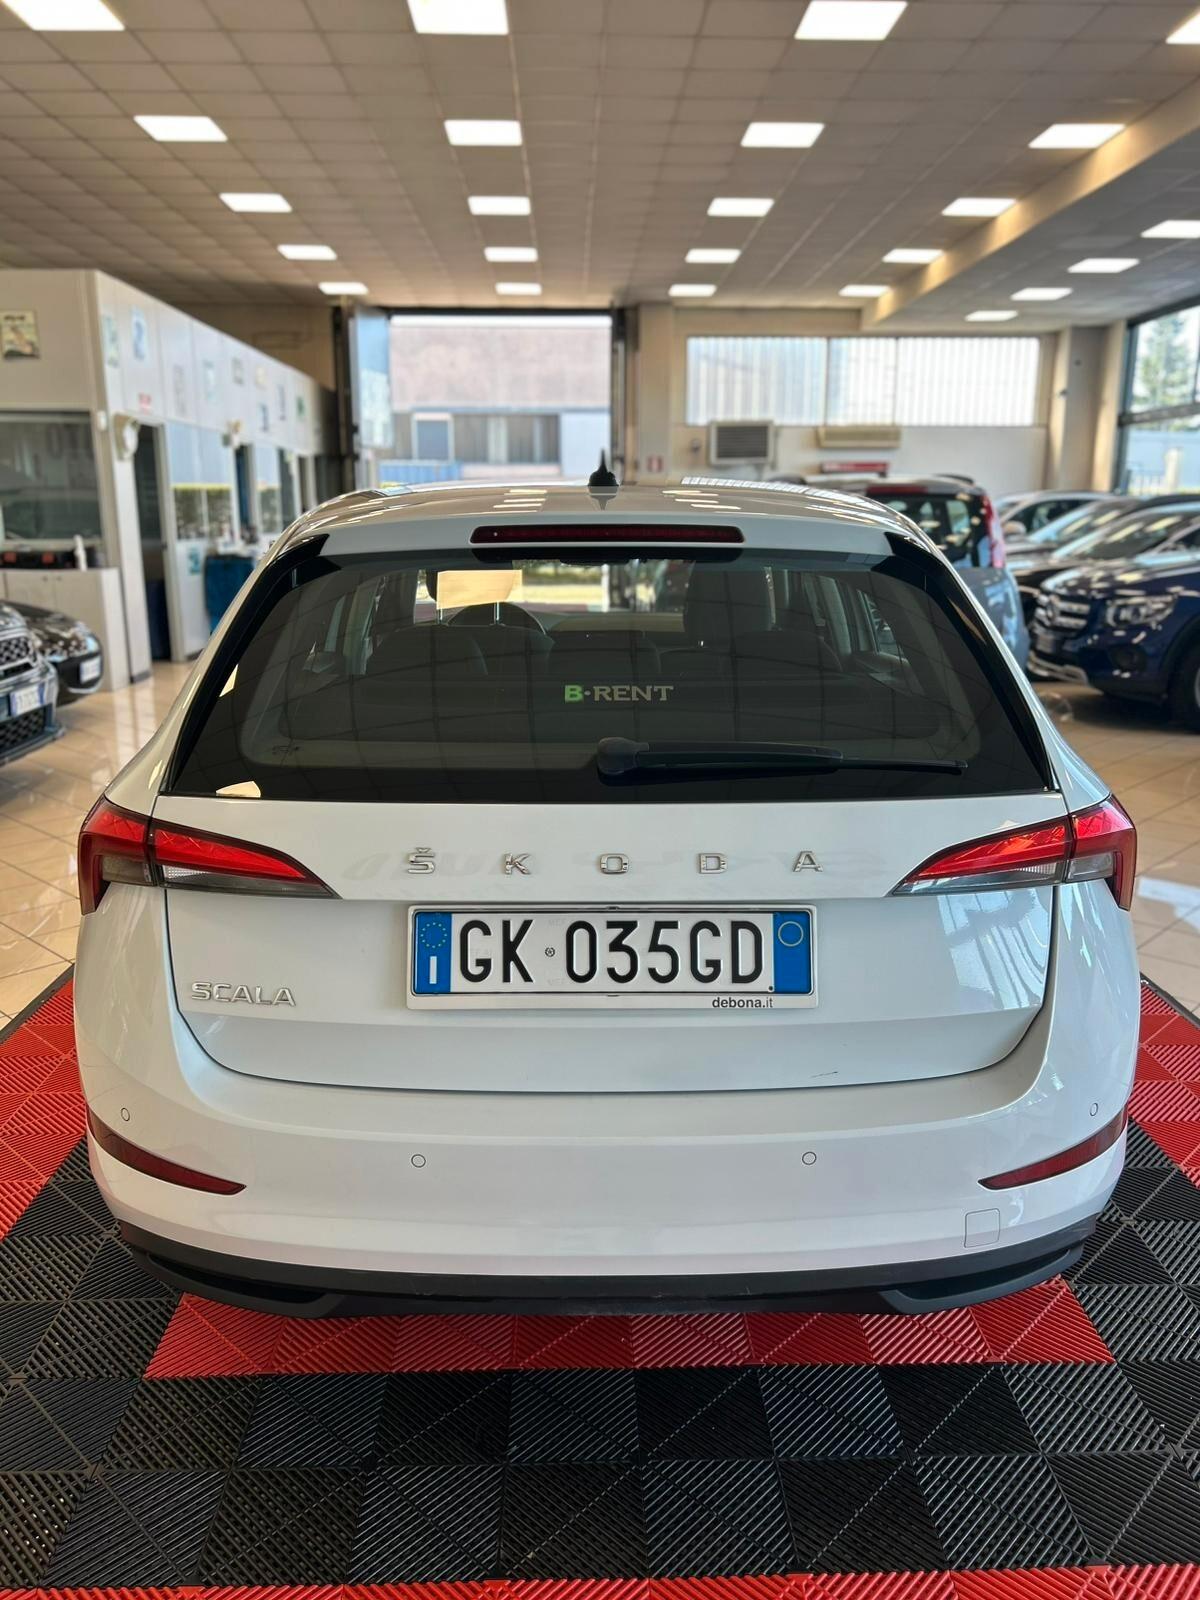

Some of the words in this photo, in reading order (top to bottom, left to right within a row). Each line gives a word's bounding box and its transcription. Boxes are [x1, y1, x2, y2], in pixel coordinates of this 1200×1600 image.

[407, 847, 824, 875] ŠKODA
[460, 919, 534, 983] GK
[566, 920, 763, 984] 035GD
[191, 981, 296, 1006] SCALA
[712, 997, 773, 1008] debona.it
